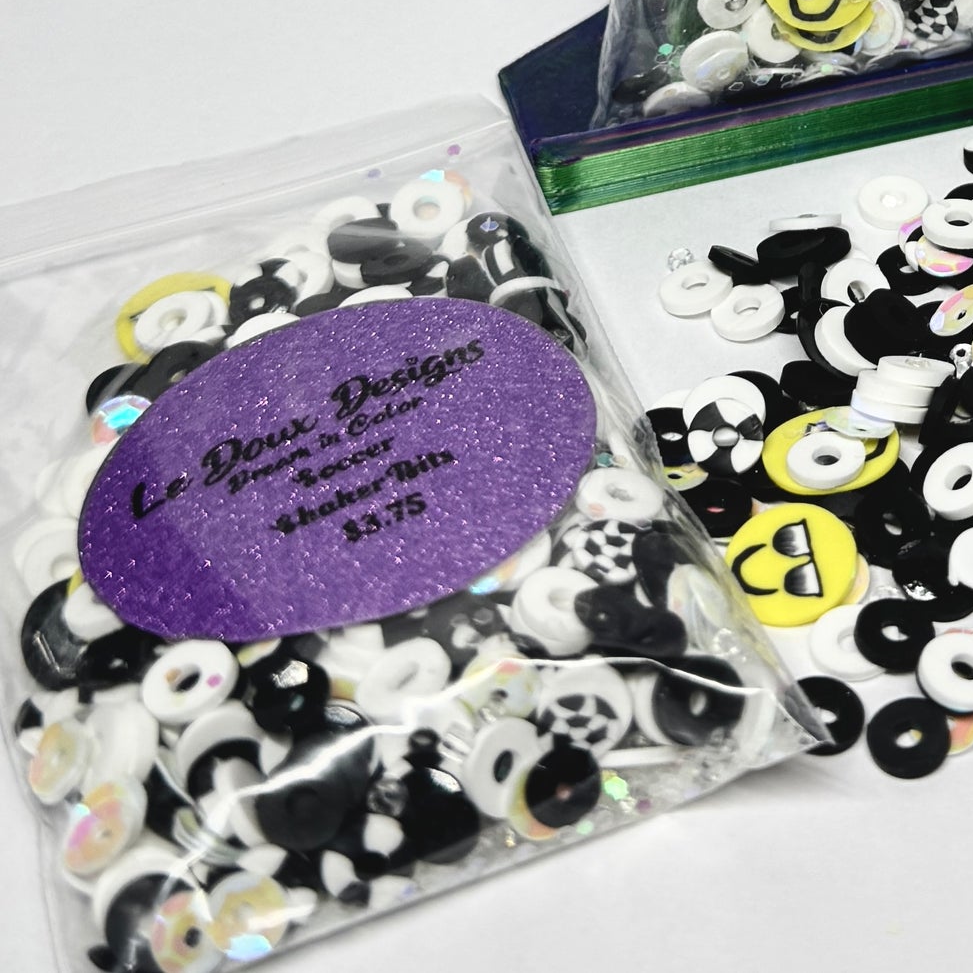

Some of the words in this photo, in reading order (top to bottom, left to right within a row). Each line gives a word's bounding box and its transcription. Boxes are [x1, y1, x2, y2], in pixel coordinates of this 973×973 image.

[131, 475, 193, 519] Le
[202, 415, 318, 487] Doux
[332, 339, 484, 420] Designs
[228, 444, 310, 495] Dream
[319, 431, 340, 450] in
[347, 395, 424, 436] Color
[294, 436, 395, 488] Soccer
[271, 474, 382, 535] Shaker
[385, 448, 454, 484] Bits
[342, 491, 427, 543] $3.75
